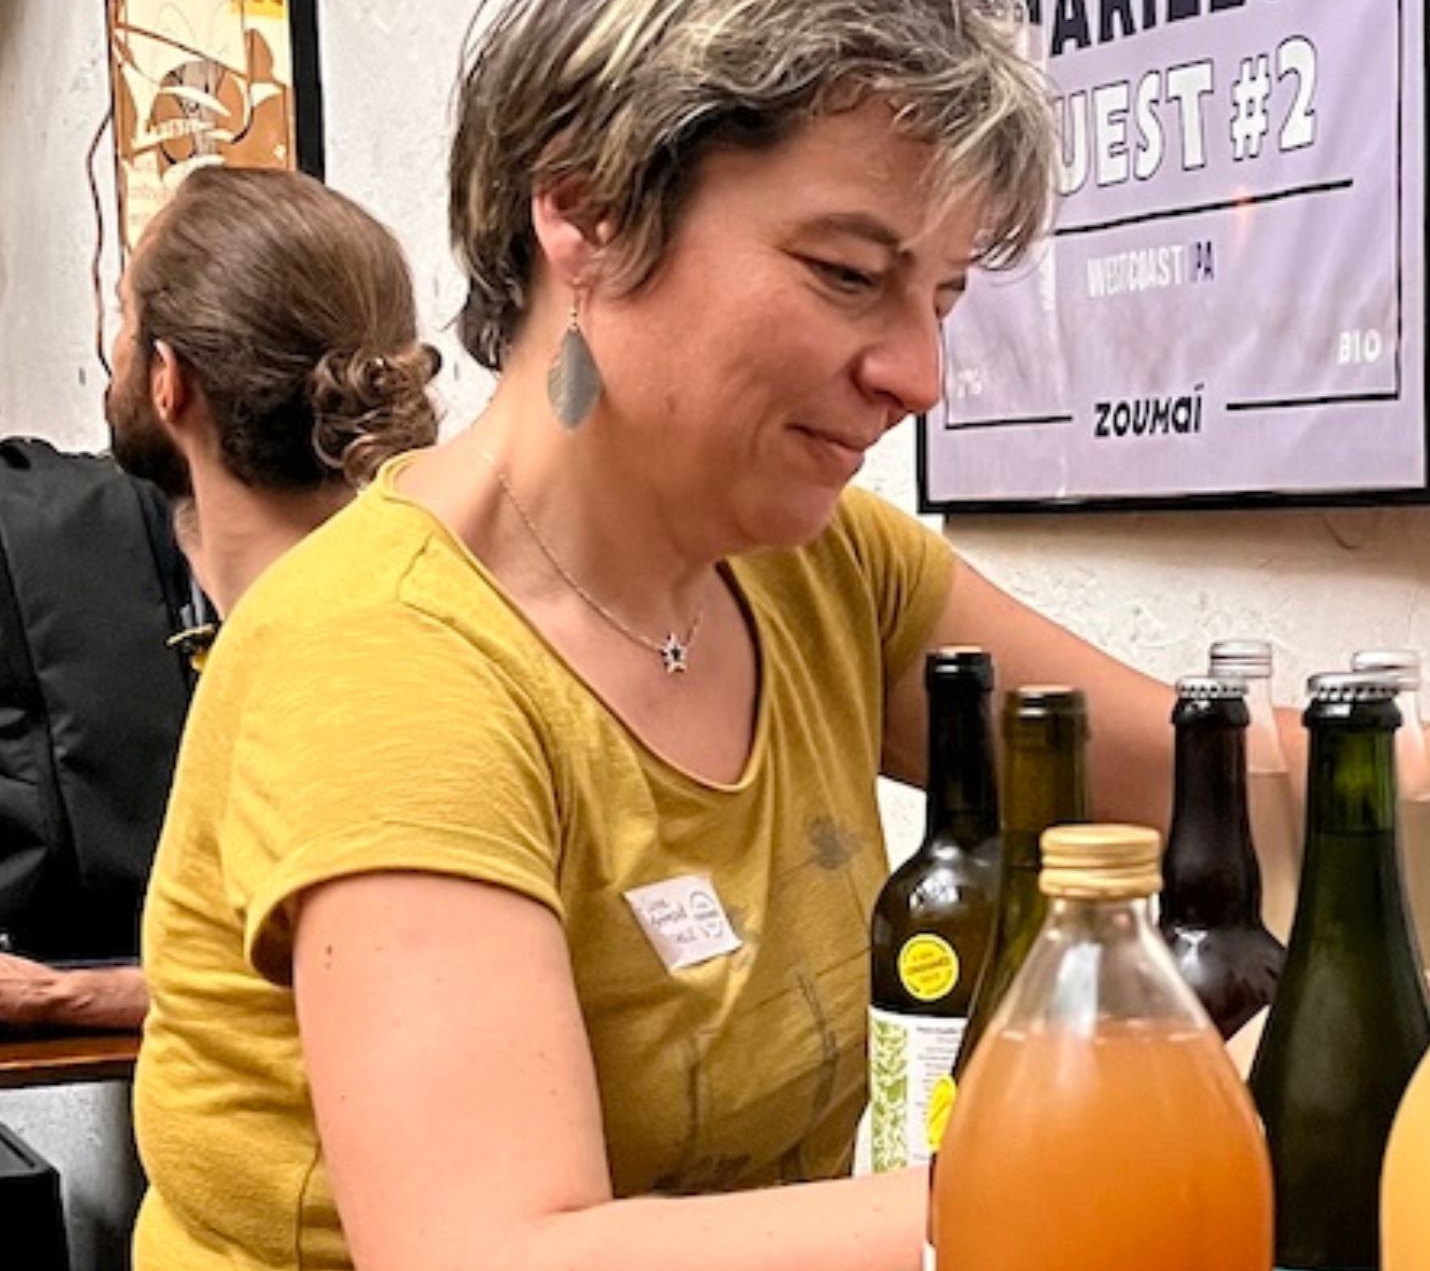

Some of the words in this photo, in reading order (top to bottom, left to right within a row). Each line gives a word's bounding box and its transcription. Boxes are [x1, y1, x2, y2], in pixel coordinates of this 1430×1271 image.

[1050, 58, 1214, 197] UEST
[1229, 34, 1317, 162] #2
[1337, 329, 1382, 364] BIO
